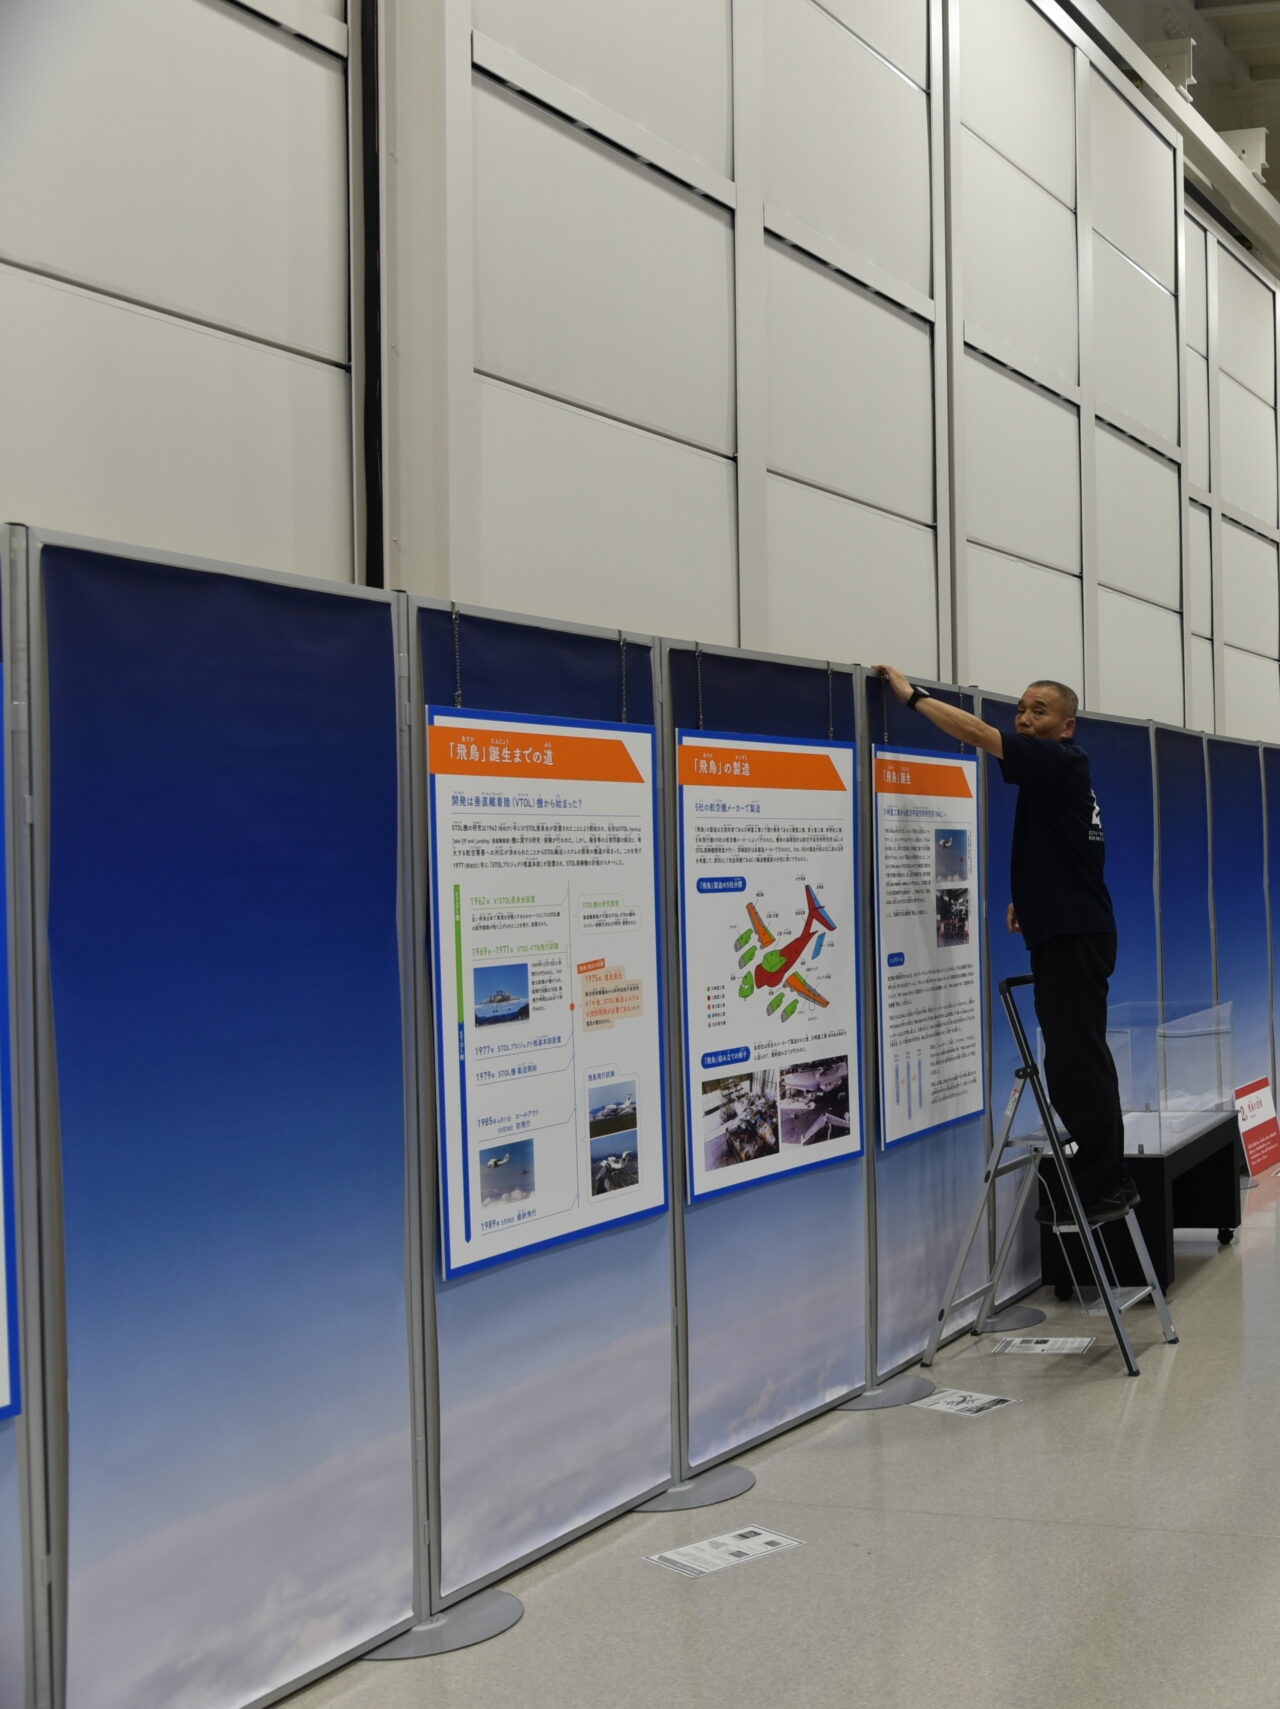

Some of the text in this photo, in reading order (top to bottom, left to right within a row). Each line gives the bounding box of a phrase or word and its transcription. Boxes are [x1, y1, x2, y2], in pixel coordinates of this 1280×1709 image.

[450, 741, 554, 765] 「飛鳥」誕生までの道
[694, 758, 751, 776] 「飛鳥」の製造
